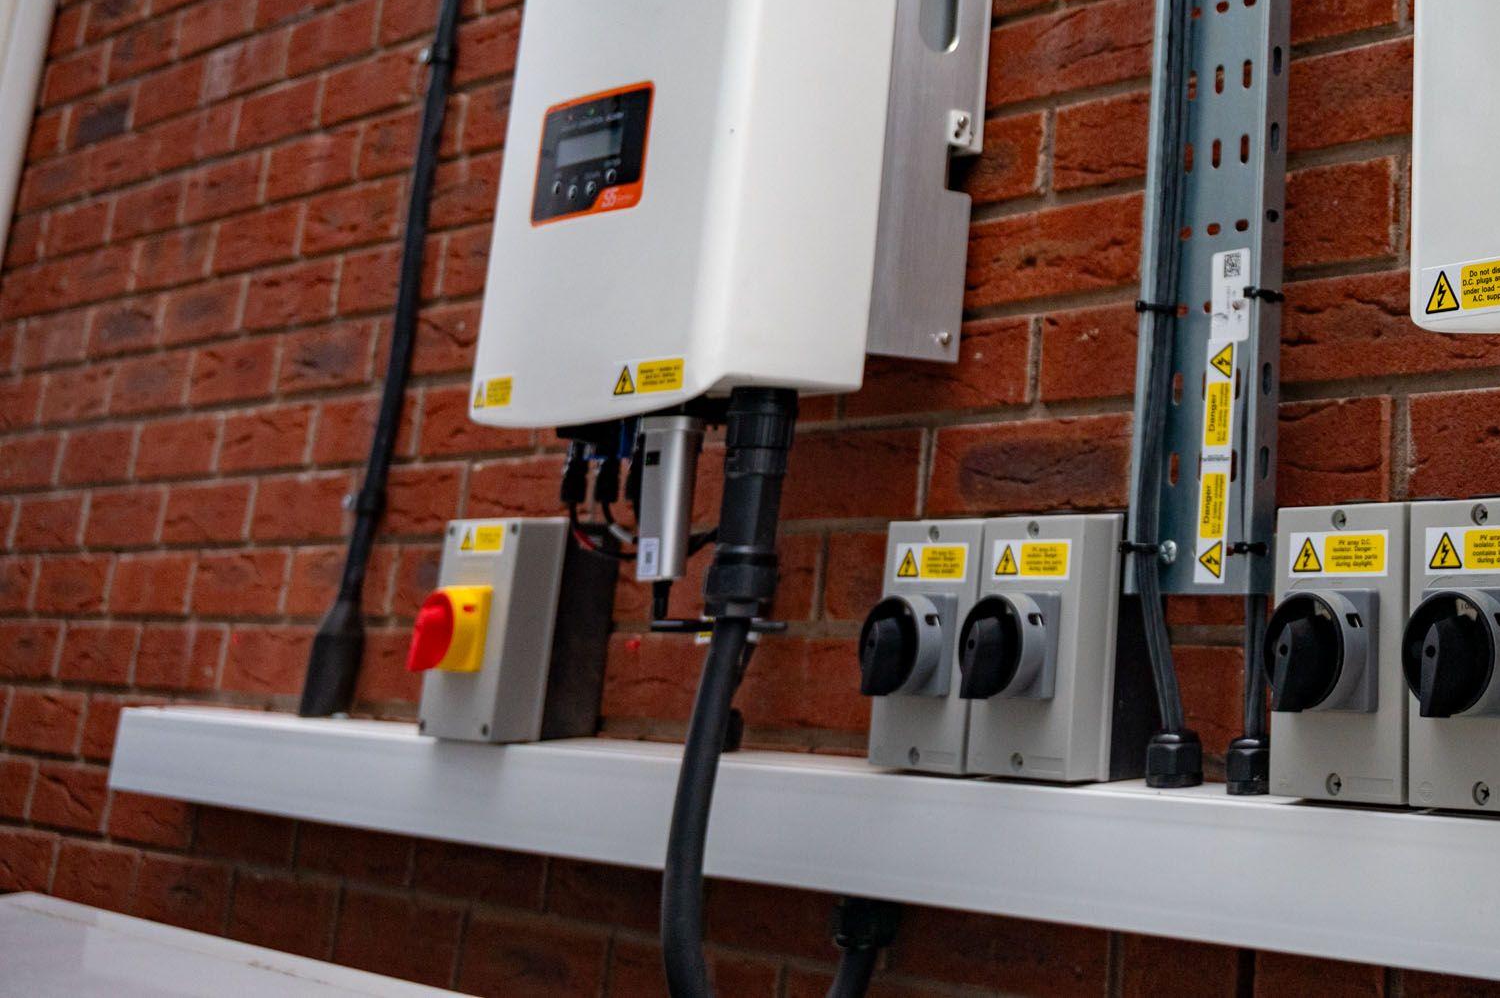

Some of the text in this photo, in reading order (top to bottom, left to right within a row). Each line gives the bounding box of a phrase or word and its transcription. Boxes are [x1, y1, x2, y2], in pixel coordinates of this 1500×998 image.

[1463, 287, 1480, 295] under
[1476, 277, 1492, 286] plugs
[1208, 394, 1217, 432] Danger
[1203, 485, 1212, 524] Danger
